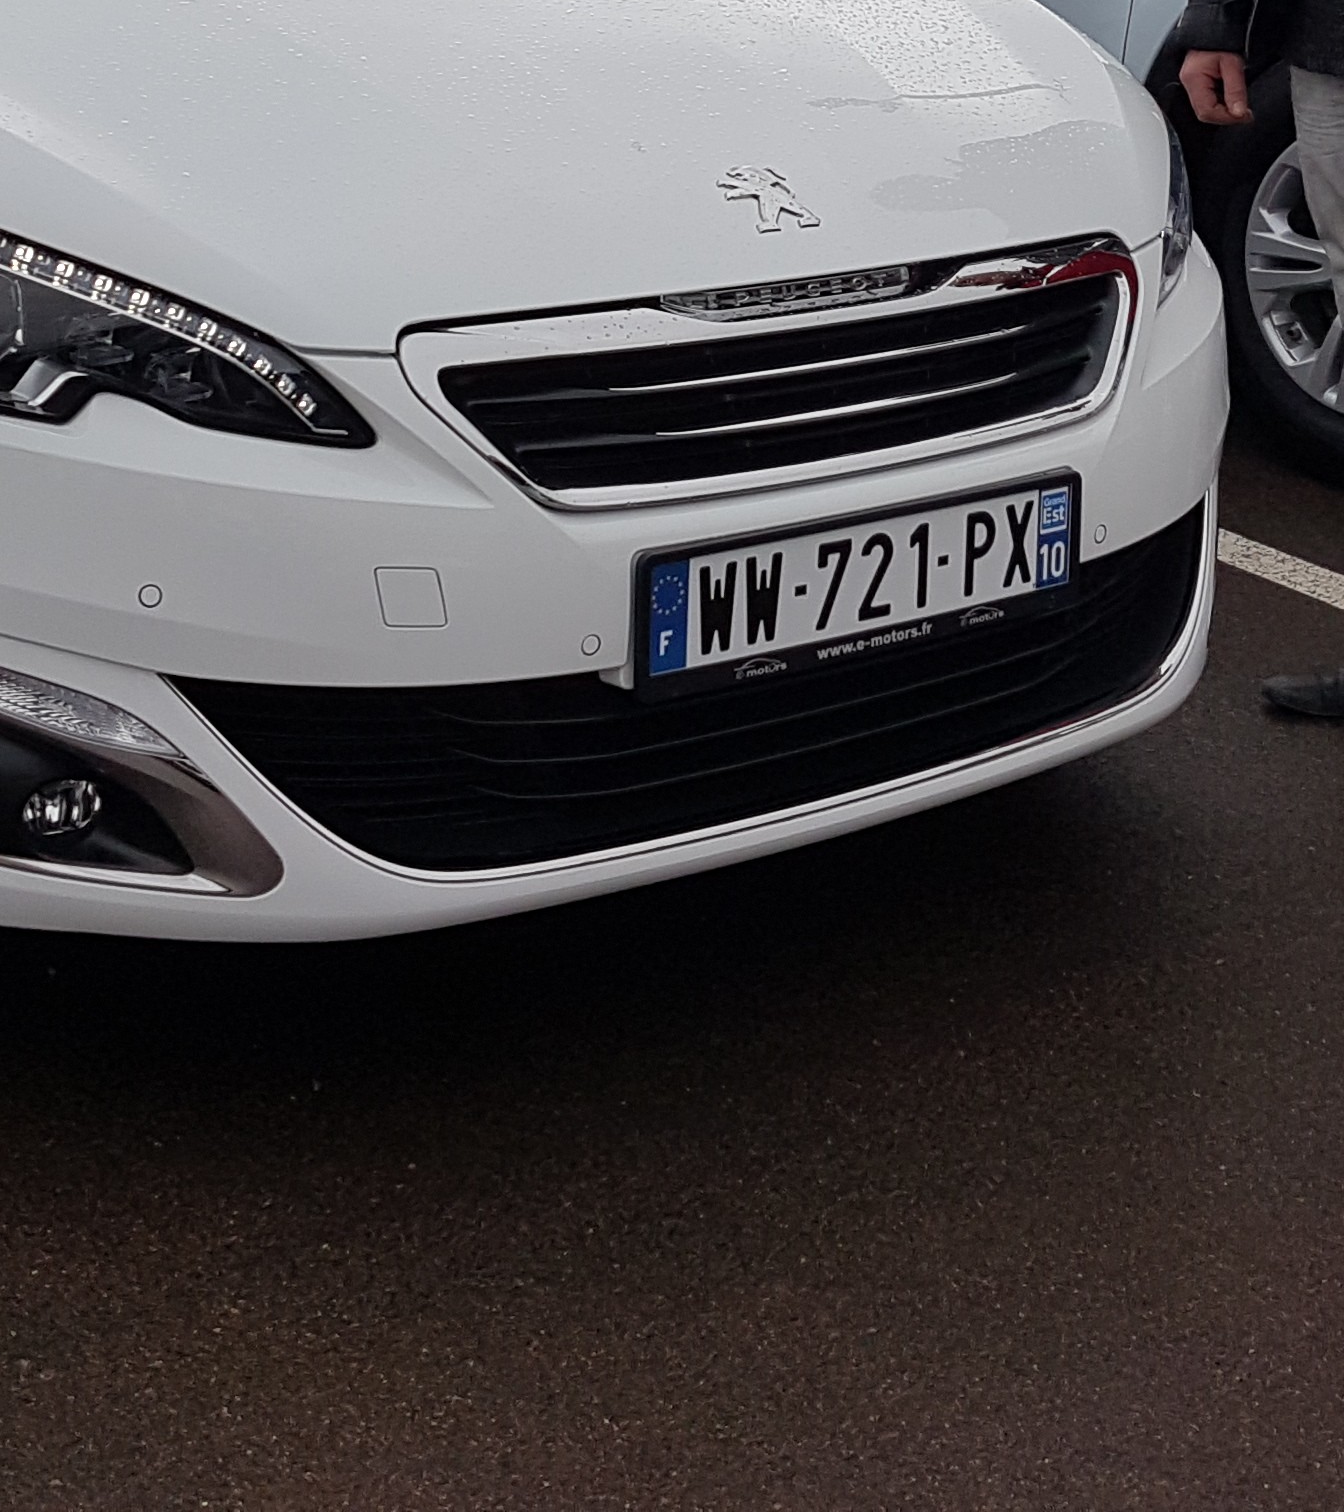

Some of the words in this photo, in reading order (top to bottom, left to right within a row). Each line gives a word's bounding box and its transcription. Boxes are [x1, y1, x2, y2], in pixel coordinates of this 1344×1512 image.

[736, 273, 887, 307] PEUGEOT
[1043, 505, 1065, 524] Est
[699, 500, 1035, 656] WW-721-PX
[1040, 541, 1066, 581] 10
[659, 629, 674, 656] F
[817, 621, 933, 660] www.e-motors.fr
